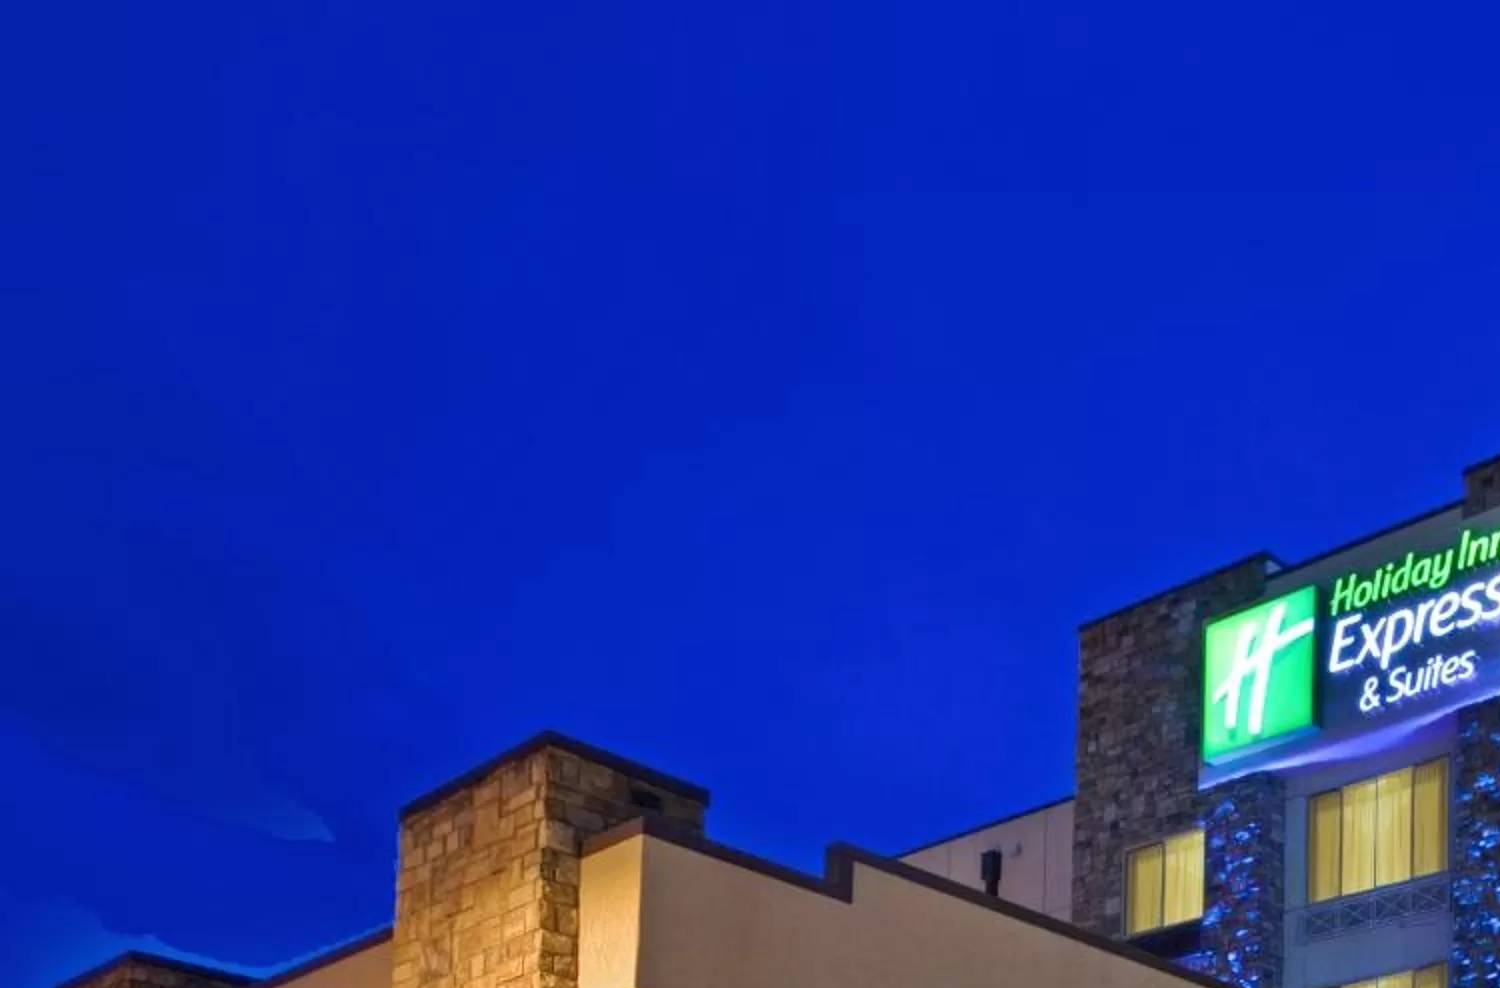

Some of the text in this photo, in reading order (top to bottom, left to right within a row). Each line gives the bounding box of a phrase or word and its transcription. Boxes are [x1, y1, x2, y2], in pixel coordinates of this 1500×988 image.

[1330, 549, 1453, 616] Holiday
[1359, 649, 1477, 711] & Suites
